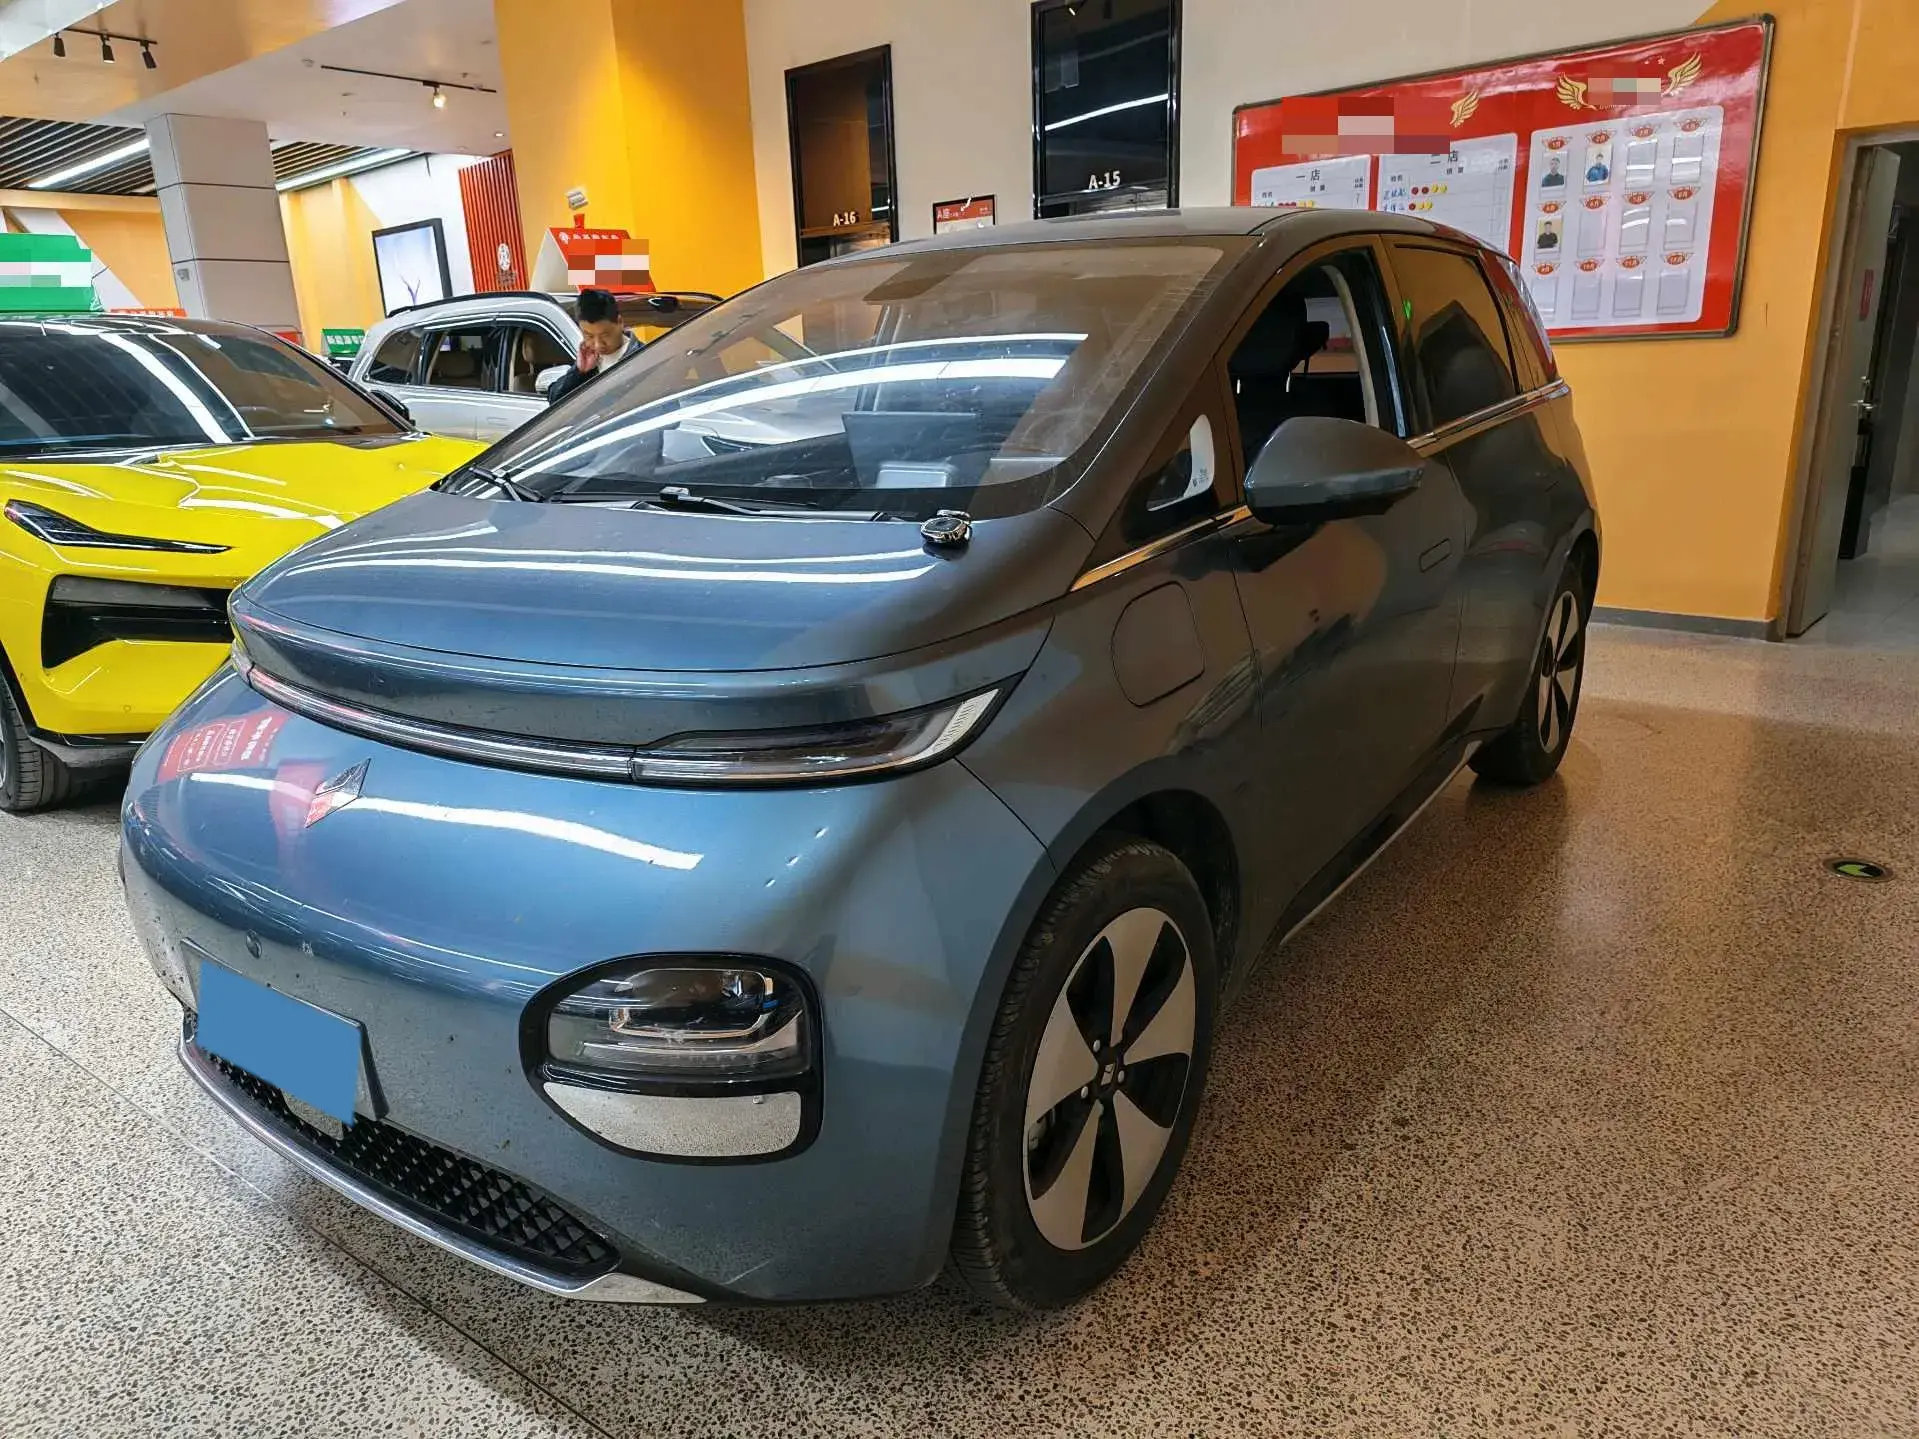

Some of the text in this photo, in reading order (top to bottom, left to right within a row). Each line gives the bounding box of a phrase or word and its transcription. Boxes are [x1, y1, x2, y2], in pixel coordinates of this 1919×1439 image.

[1089, 171, 1121, 190] A-15
[1296, 169, 1321, 181] 一店
[833, 211, 856, 227] A-16
